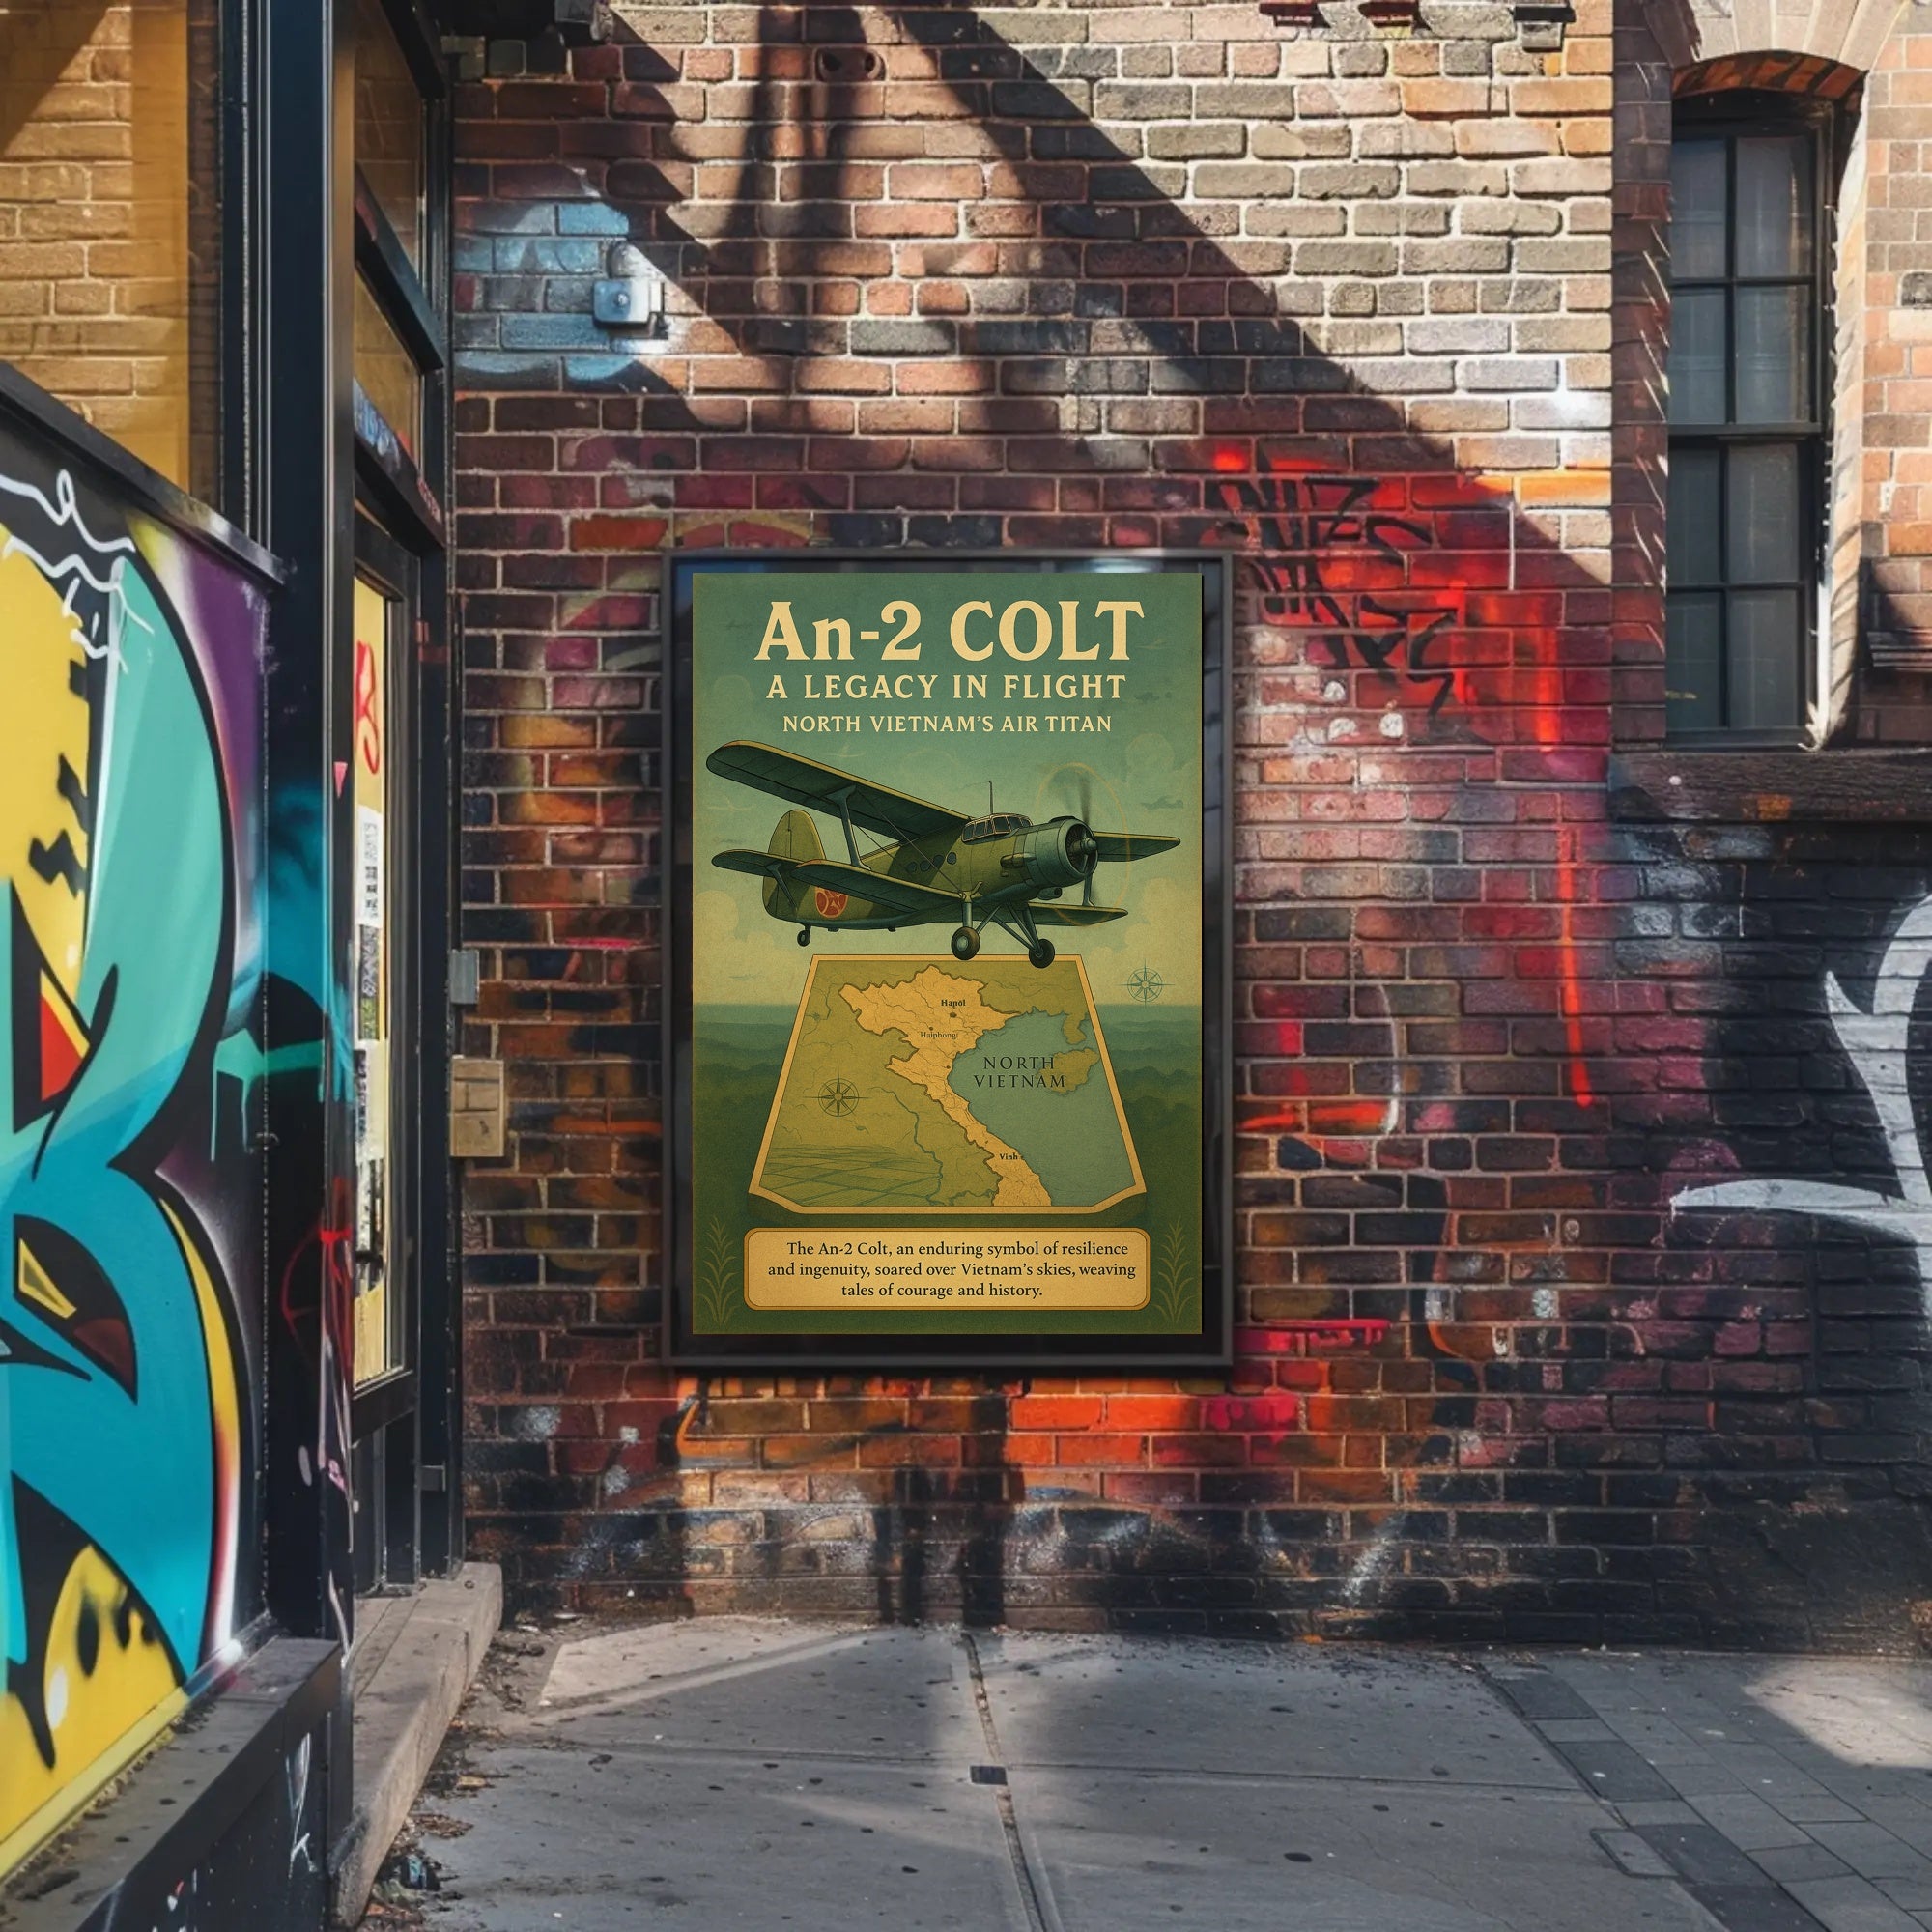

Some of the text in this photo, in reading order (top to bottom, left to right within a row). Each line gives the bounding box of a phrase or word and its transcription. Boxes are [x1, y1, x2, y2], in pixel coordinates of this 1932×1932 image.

[753, 600, 1145, 662] An-2 COLT
[766, 674, 1126, 699] A LEGACY IN FLIGHT
[782, 715, 1111, 733] NORTH VIETNAM’S AIR TITAN
[920, 1031, 957, 1040] Haiphong
[983, 1056, 1054, 1069] NORTH
[974, 1074, 1065, 1088] VIETNAM
[786, 1240, 1128, 1260] The An-2 Colt, an enduring symbol of resilience
[768, 1261, 795, 1276] and
[799, 1262, 870, 1280] ingenuity,
[874, 1262, 922, 1276] soared
[926, 1265, 957, 1276] over
[1037, 1261, 1076, 1279] skies,
[1078, 1262, 1137, 1280] weaving
[841, 1282, 1043, 1300] tales of courage and history.
